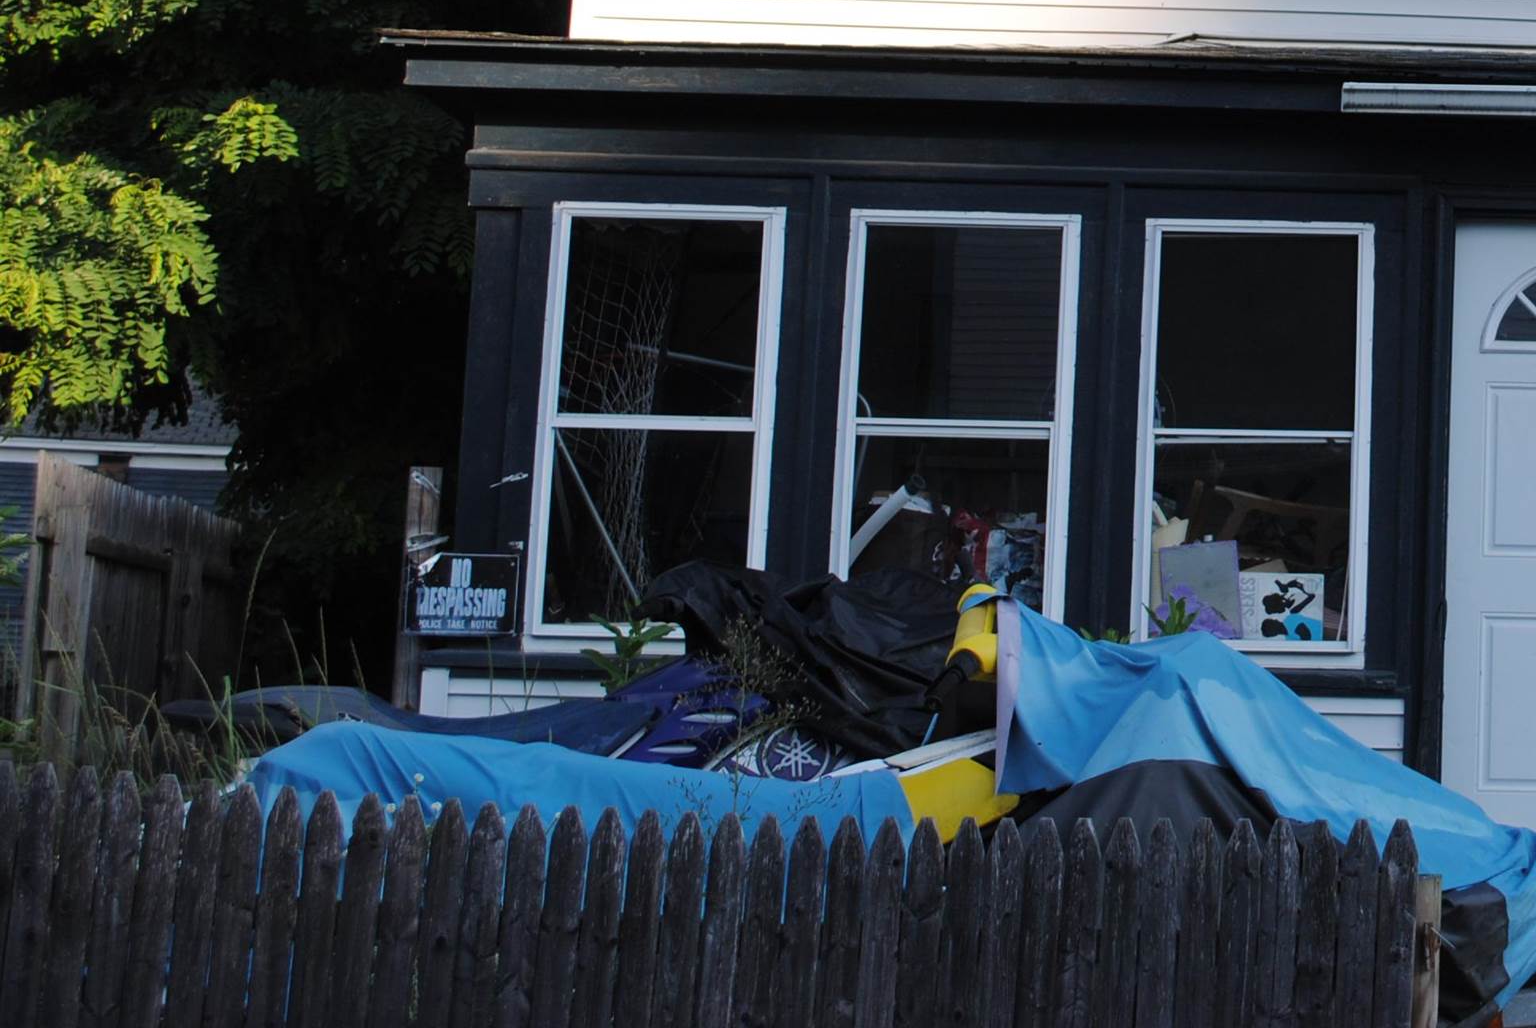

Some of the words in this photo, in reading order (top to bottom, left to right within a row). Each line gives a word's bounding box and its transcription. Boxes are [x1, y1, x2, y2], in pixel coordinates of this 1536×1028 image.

[450, 558, 473, 588] NO
[447, 619, 466, 629] TAKE
[470, 619, 498, 630] NOTICE
